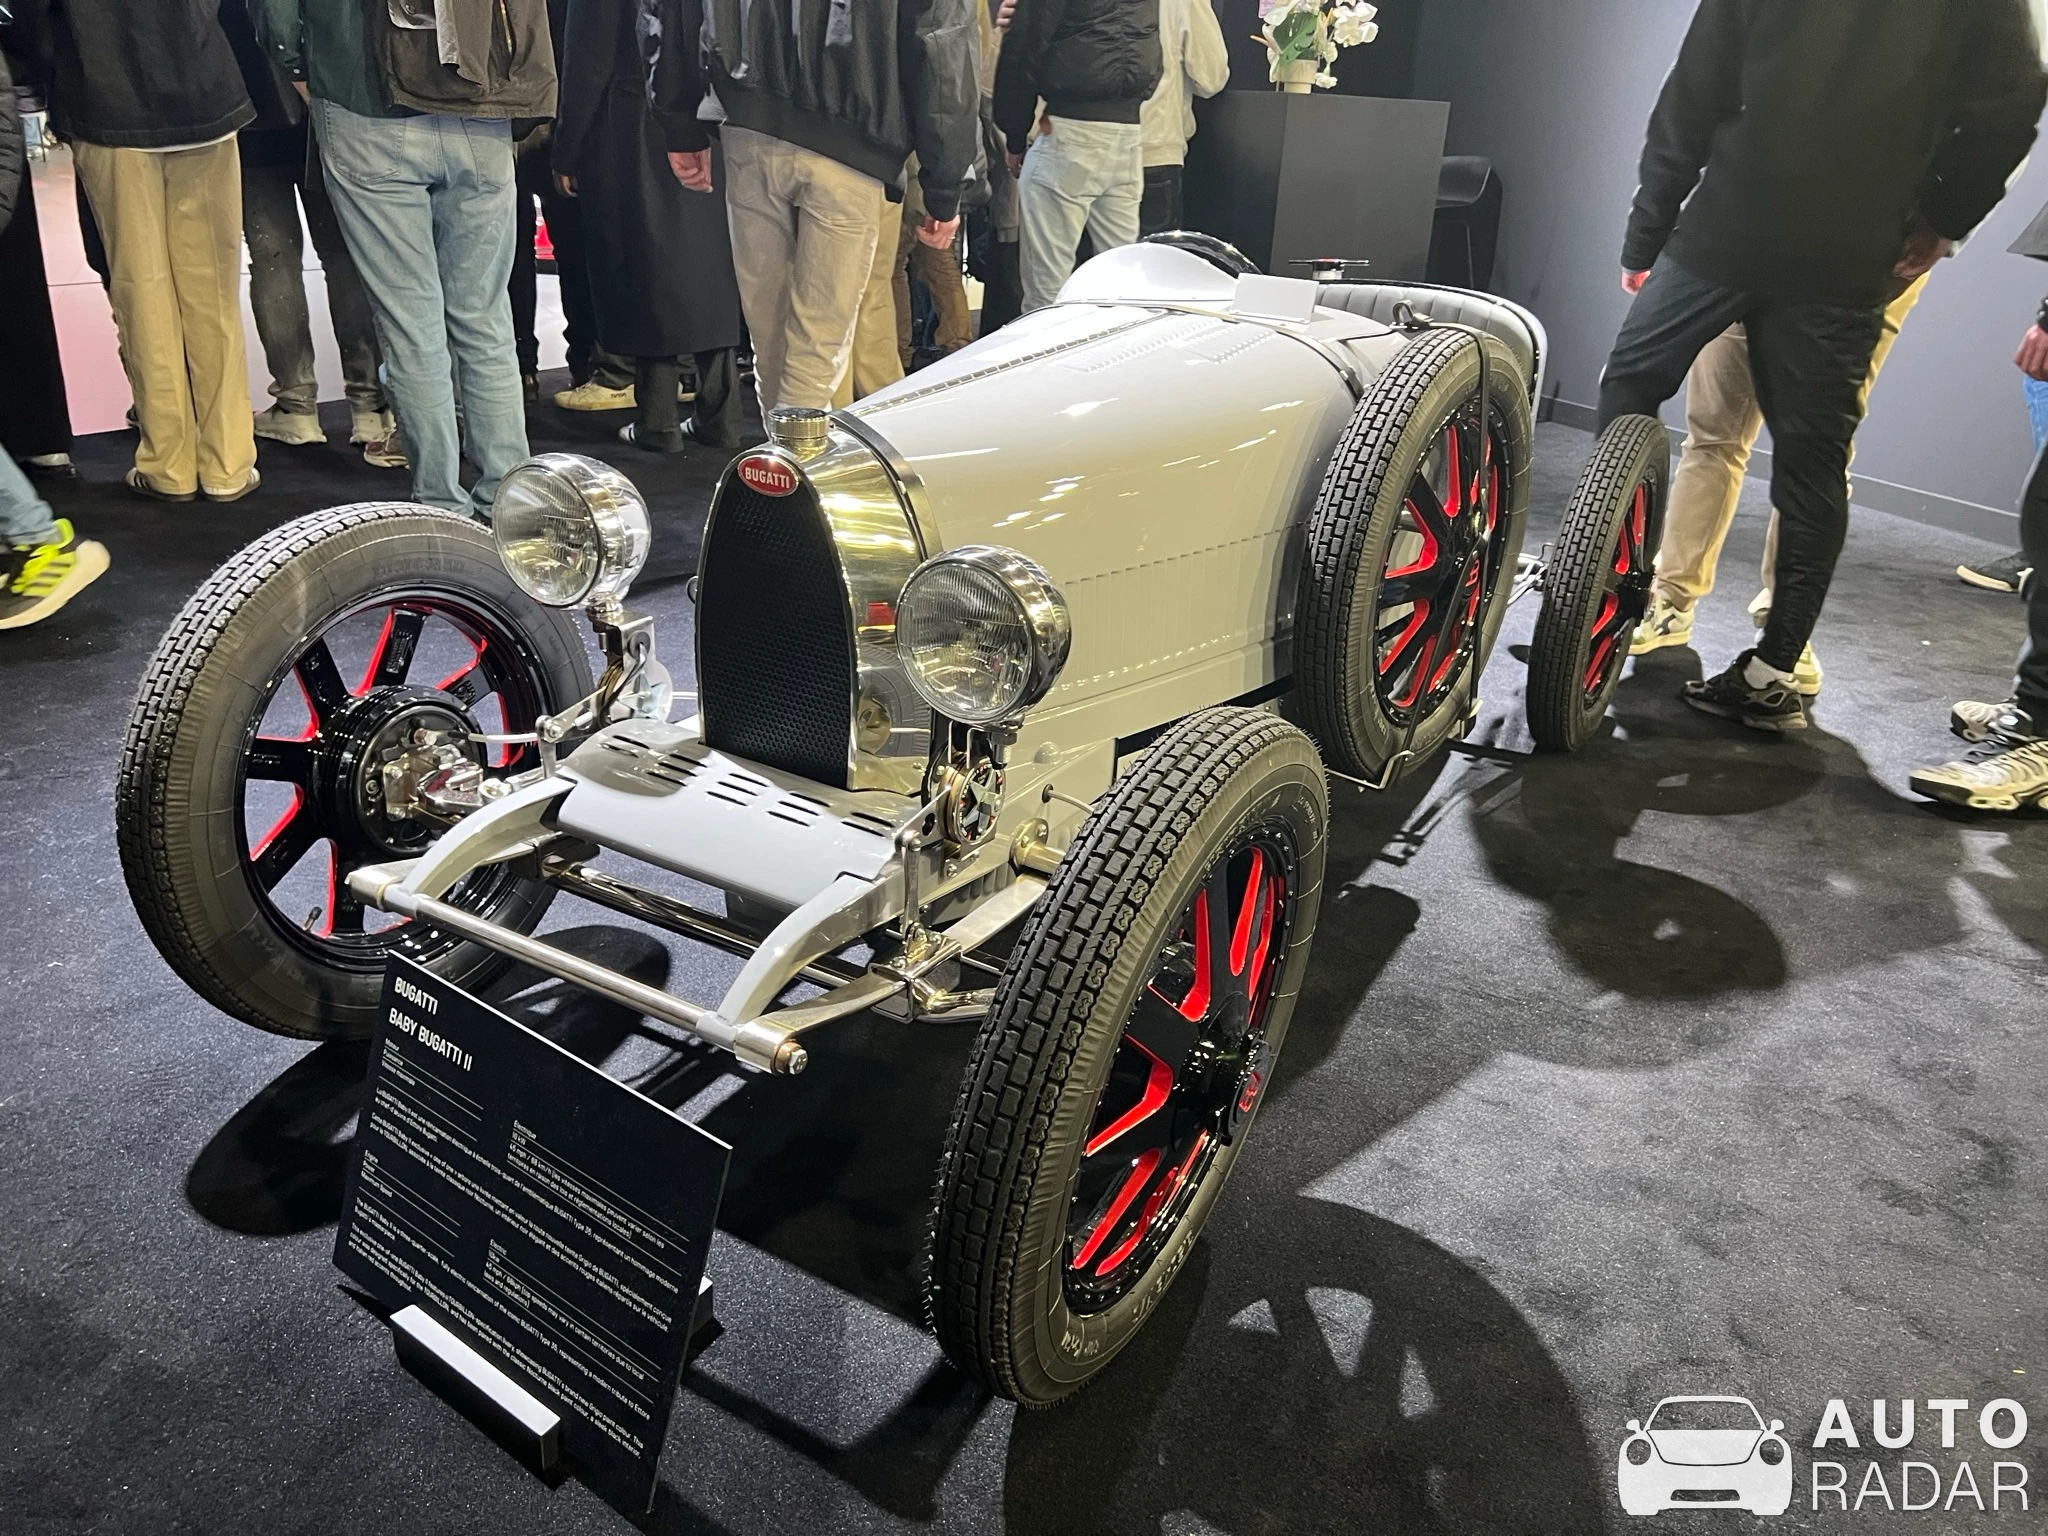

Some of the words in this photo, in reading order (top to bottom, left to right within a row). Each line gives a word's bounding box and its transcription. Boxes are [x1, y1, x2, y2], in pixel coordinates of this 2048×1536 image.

[745, 466, 791, 490] BUGATTI
[394, 976, 438, 1015] BUGATTI
[388, 1007, 417, 1037] BABY
[417, 1025, 462, 1064] BUGATTI
[462, 1053, 472, 1071] II
